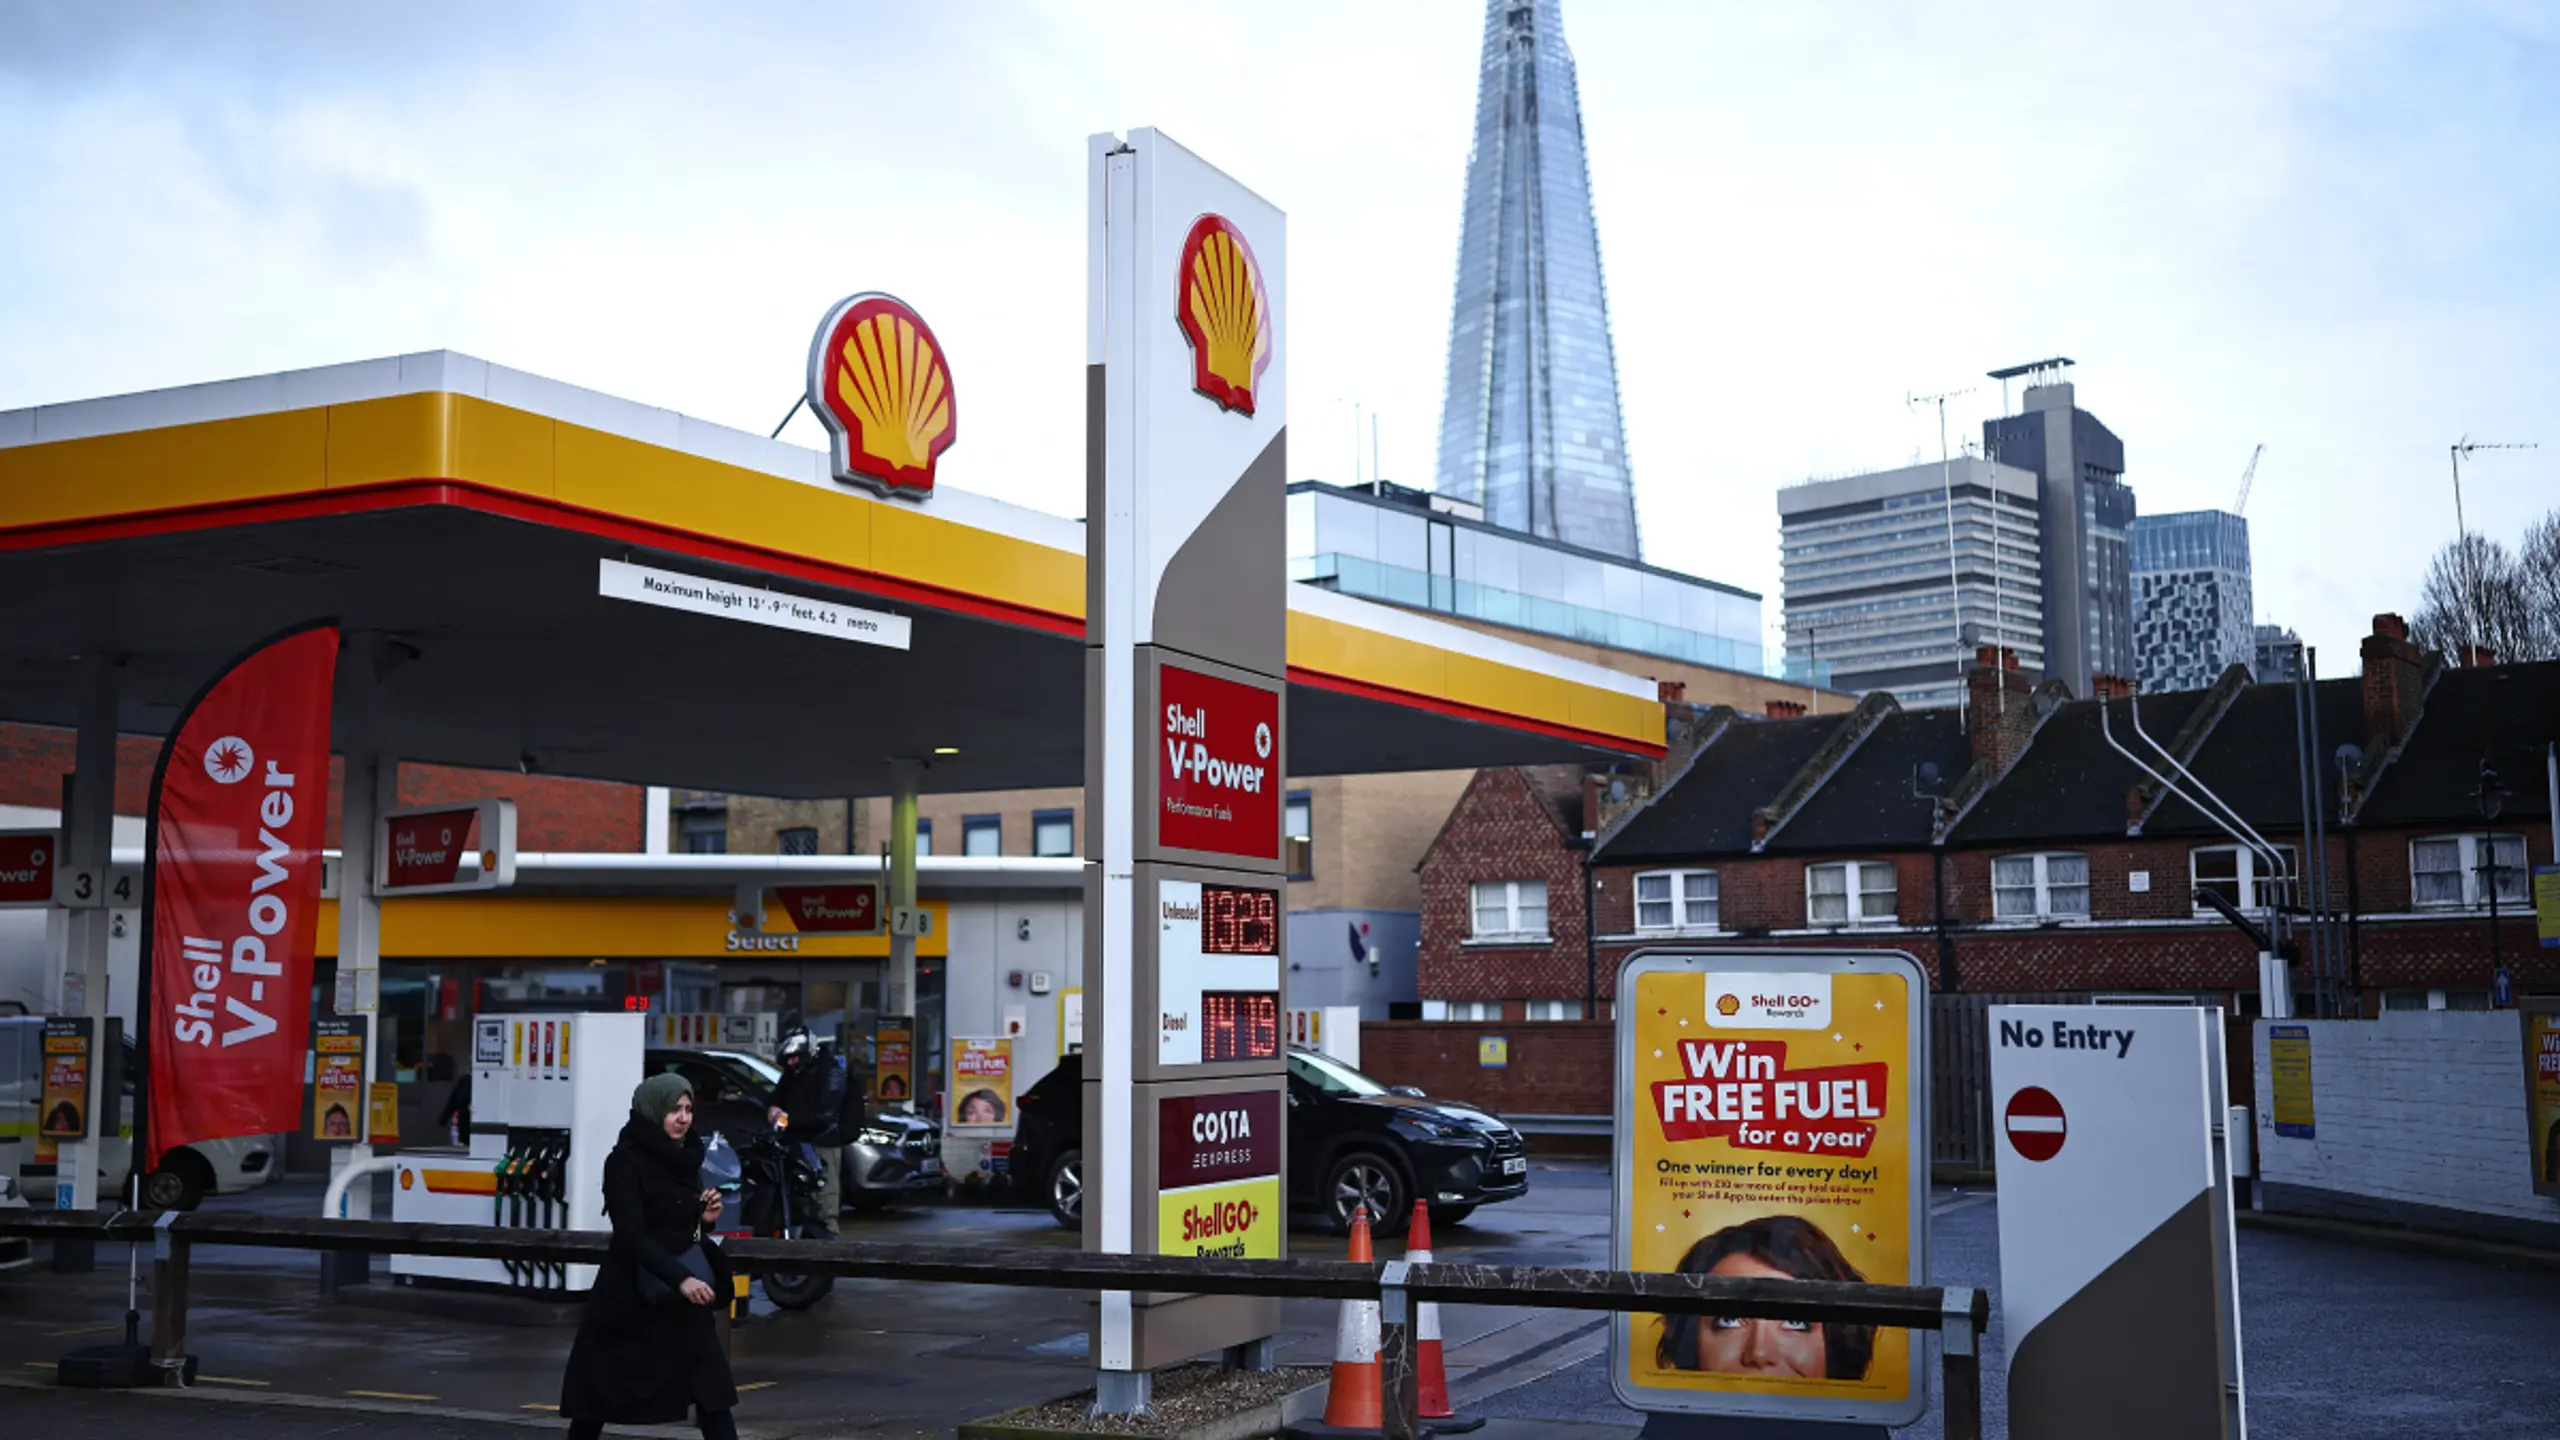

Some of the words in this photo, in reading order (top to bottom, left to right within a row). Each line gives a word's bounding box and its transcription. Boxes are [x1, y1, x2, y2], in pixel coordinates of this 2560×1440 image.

[643, 576, 703, 600] Maximum
[706, 588, 742, 608] height
[1167, 703, 1205, 739] Shell
[1167, 737, 1264, 794] V-Power
[396, 848, 447, 868] V-Power
[74, 872, 93, 900] 3
[113, 875, 131, 902] 4
[221, 760, 295, 1048] V-Power
[802, 905, 864, 920] V-Power
[899, 912, 908, 931] 7
[919, 914, 927, 933] 8
[726, 930, 800, 951] Select
[174, 936, 223, 1048] Shell
[1751, 993, 1785, 1008] Shell
[1788, 995, 1820, 1008] GO+
[2000, 1019, 2044, 1048] No
[2052, 1020, 2135, 1059] Entry
[2541, 1033, 2560, 1052] Wi
[1684, 1041, 1775, 1080] Win
[1663, 1082, 1764, 1122] FREE
[1774, 1079, 1881, 1120] FUEL
[1192, 1109, 1251, 1144] COSTA
[1739, 1121, 1776, 1145] for
[1783, 1130, 1800, 1145] a
[1657, 1158, 1691, 1174] One
[1694, 1160, 1754, 1175] winner
[1758, 1160, 1782, 1176] for
[1786, 1166, 1835, 1182] every
[1839, 1163, 1878, 1184] day!
